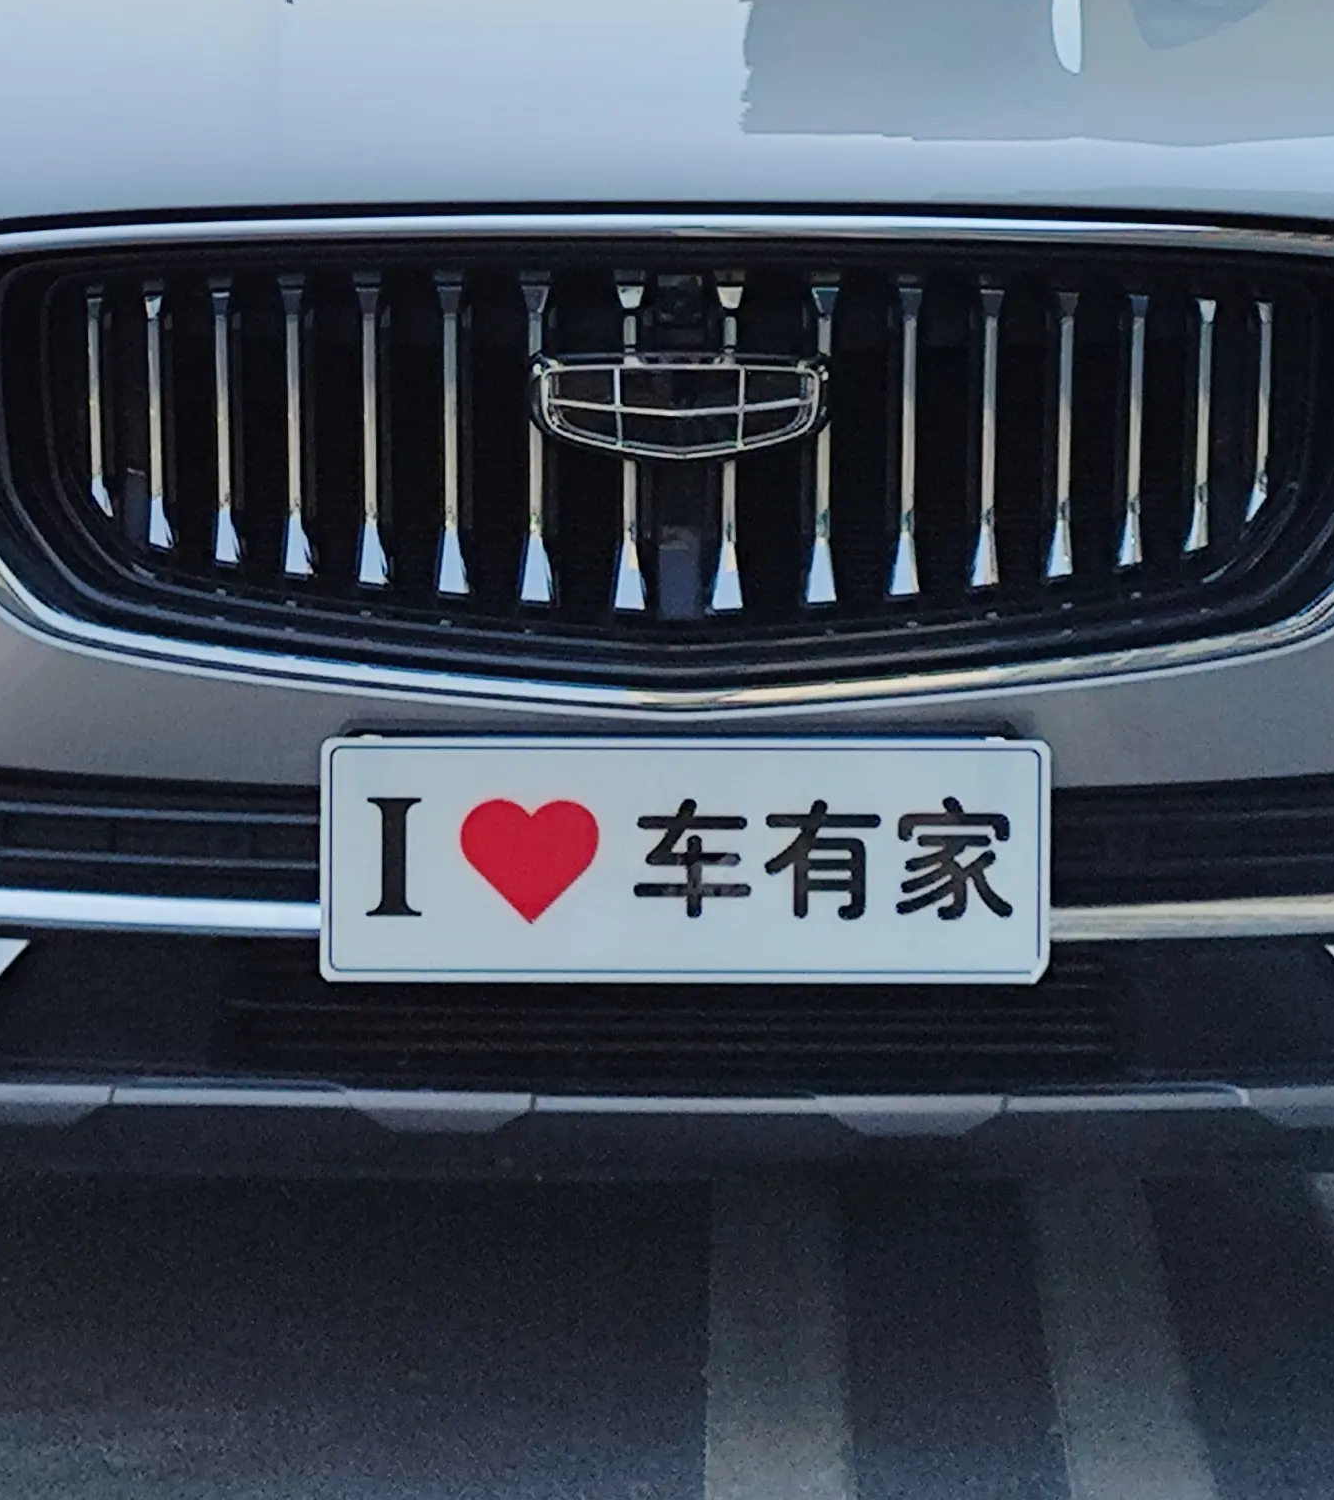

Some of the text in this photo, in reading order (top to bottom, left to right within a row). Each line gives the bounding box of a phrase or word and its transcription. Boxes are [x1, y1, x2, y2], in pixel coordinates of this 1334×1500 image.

[365, 796, 1014, 920] I 车有家
